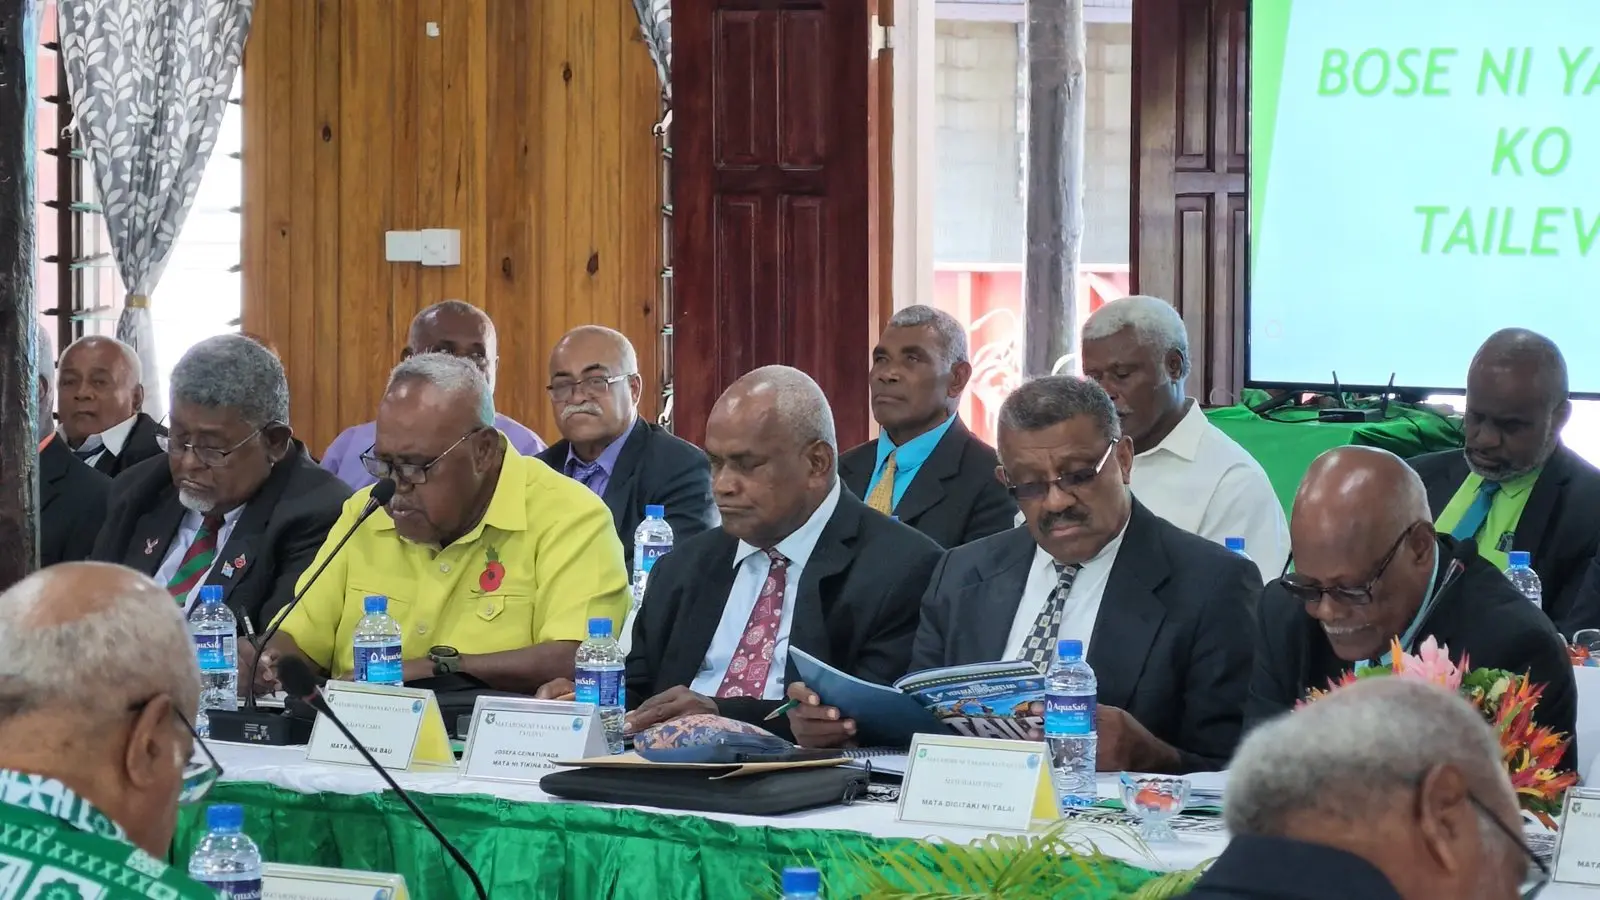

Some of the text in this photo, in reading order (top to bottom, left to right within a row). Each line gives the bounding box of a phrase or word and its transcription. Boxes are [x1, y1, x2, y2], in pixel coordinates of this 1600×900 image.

[1317, 47, 1458, 97] BOSE
[1476, 47, 1534, 97] NI
[1491, 126, 1572, 177] KO
[1053, 702, 1088, 714] AquaSafe
[520, 761, 542, 769] TIKINA
[921, 799, 943, 807] MATA
[981, 803, 991, 811] NI
